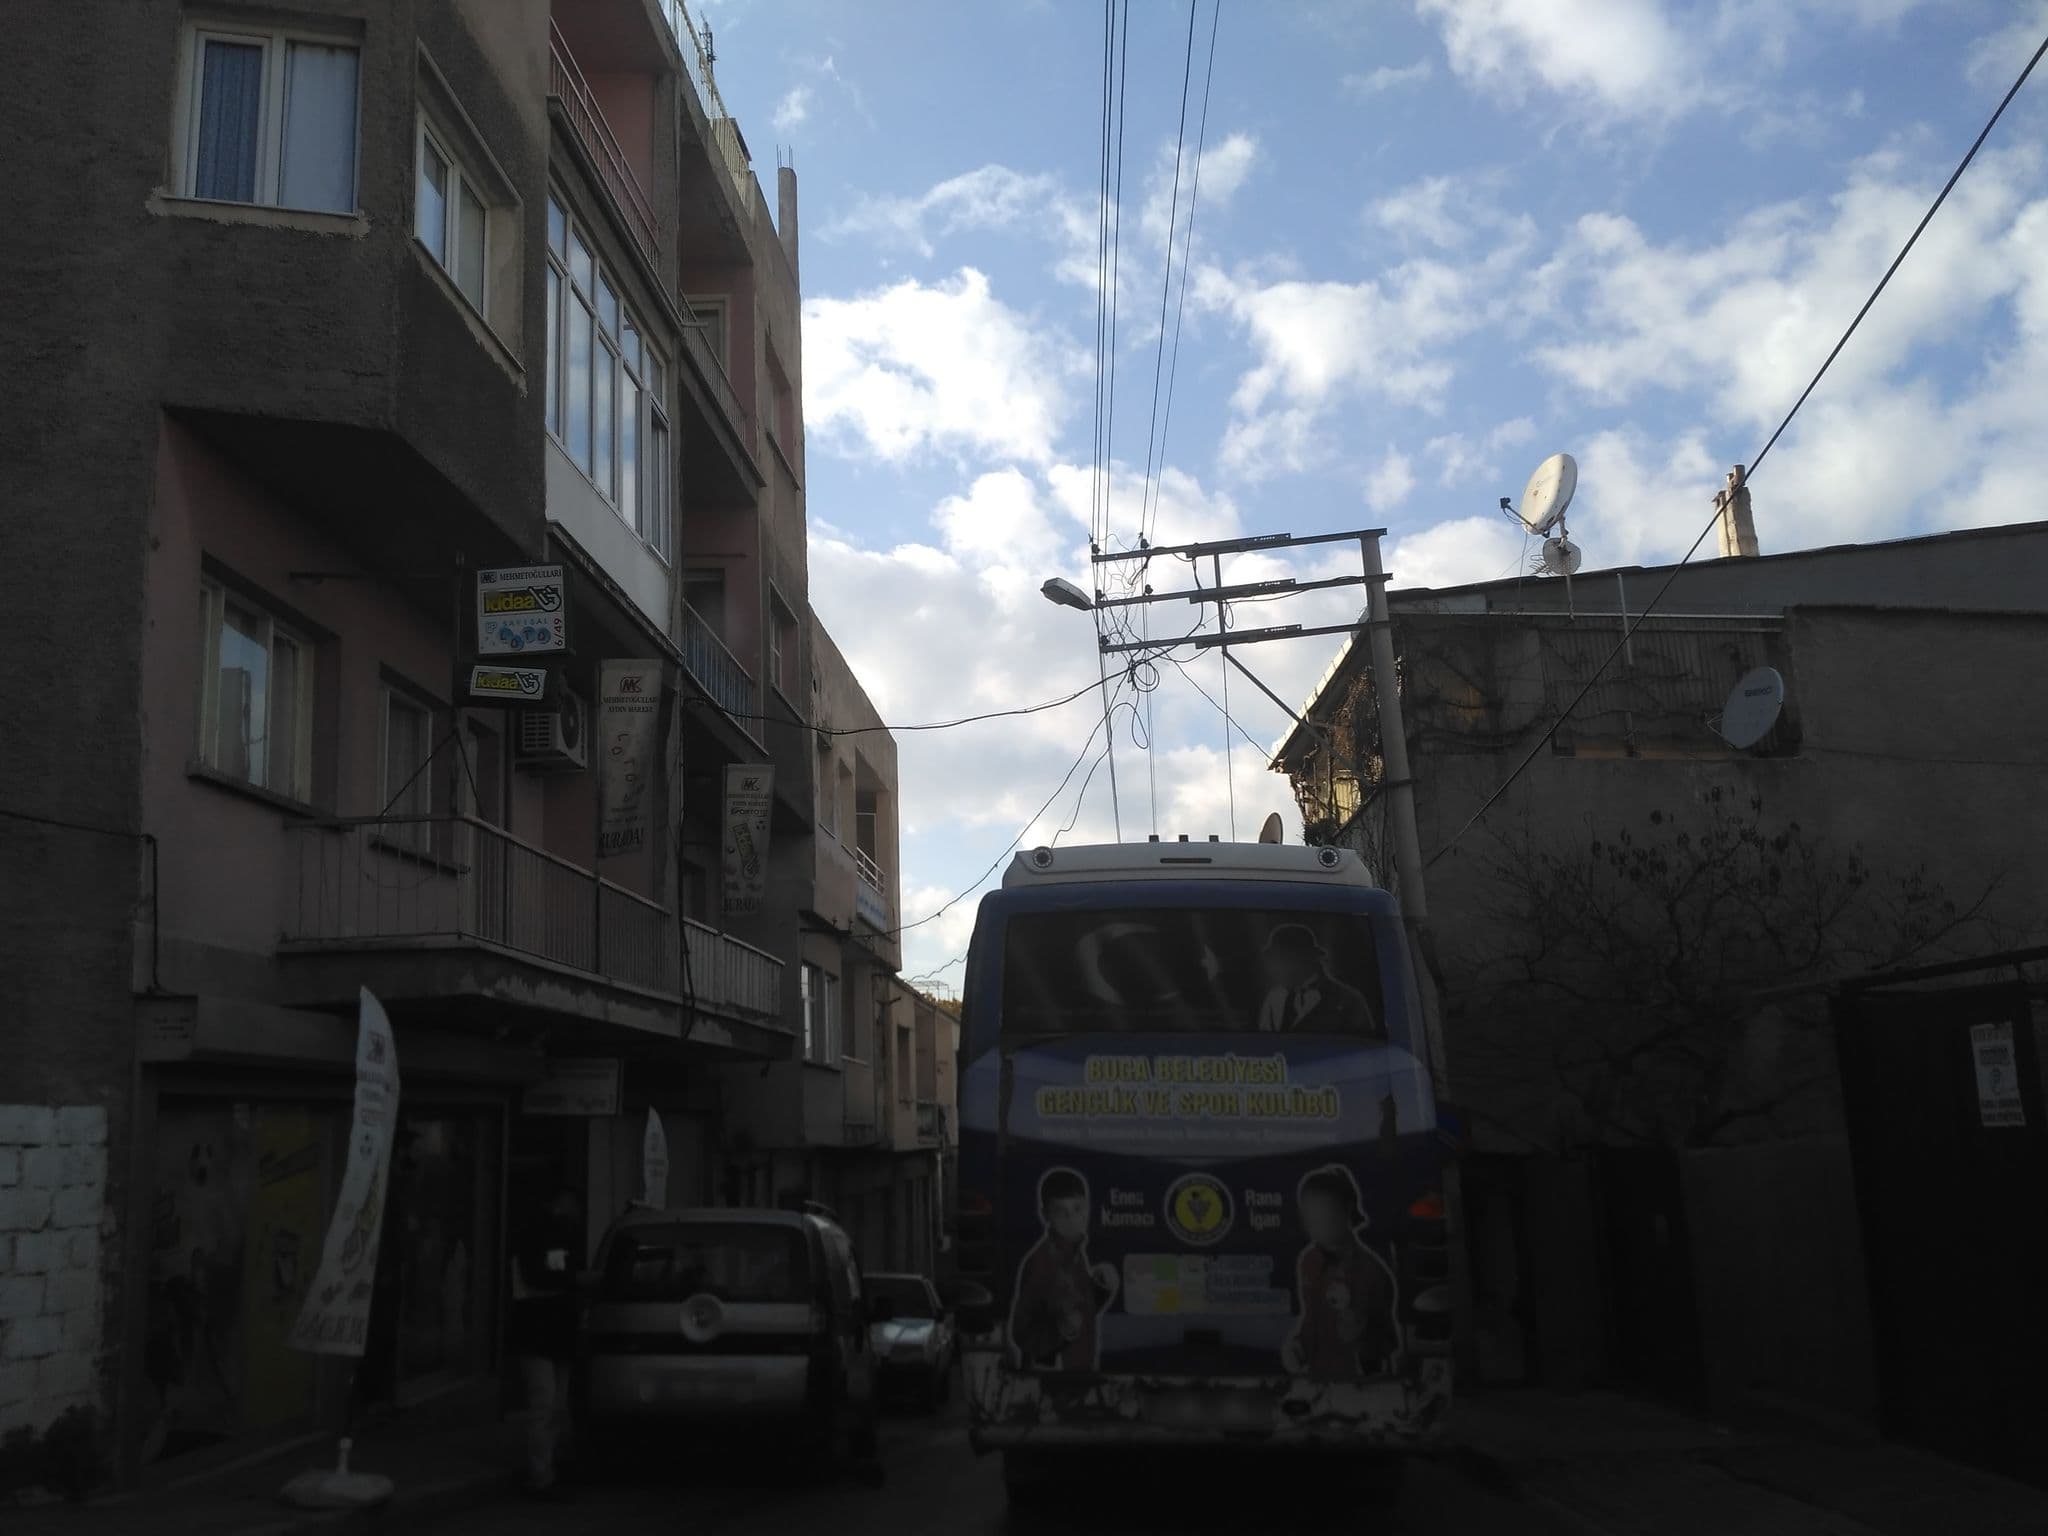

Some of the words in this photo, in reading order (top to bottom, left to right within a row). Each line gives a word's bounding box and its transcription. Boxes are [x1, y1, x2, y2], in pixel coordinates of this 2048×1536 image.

[1154, 1052, 1285, 1083] BELEDİYESİ
[1039, 1086, 1138, 1117] GENÇLİK
[1143, 1089, 1171, 1115] VE
[1178, 1089, 1240, 1115] SPOR
[1246, 1087, 1338, 1116] KULÜBÜ
